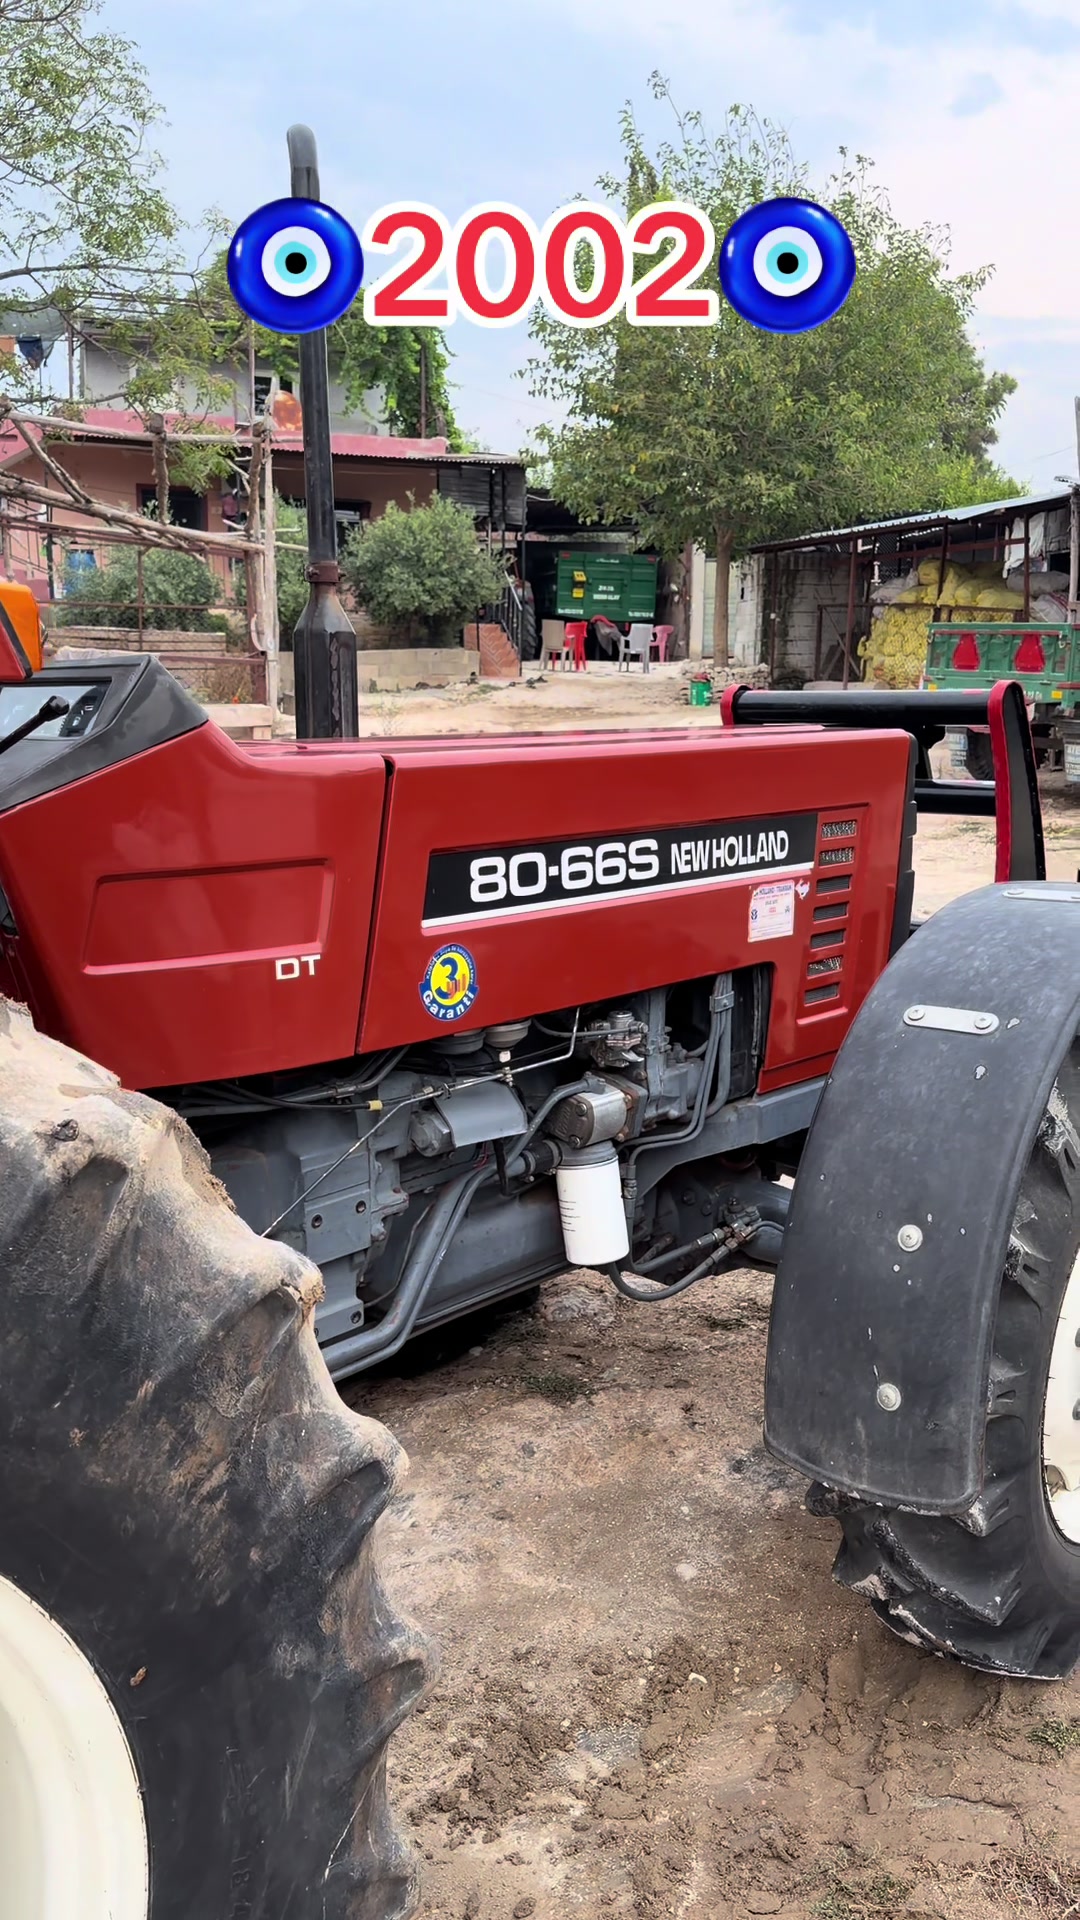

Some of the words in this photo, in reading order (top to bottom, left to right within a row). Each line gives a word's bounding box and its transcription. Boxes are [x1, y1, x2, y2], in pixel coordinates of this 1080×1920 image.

[469, 838, 660, 903] 80-66S
[670, 839, 710, 875] NEW
[712, 830, 789, 869] HOLLAND
[275, 953, 321, 980] DT
[434, 956, 459, 1000] 3
[422, 990, 475, 1019] Garanti
